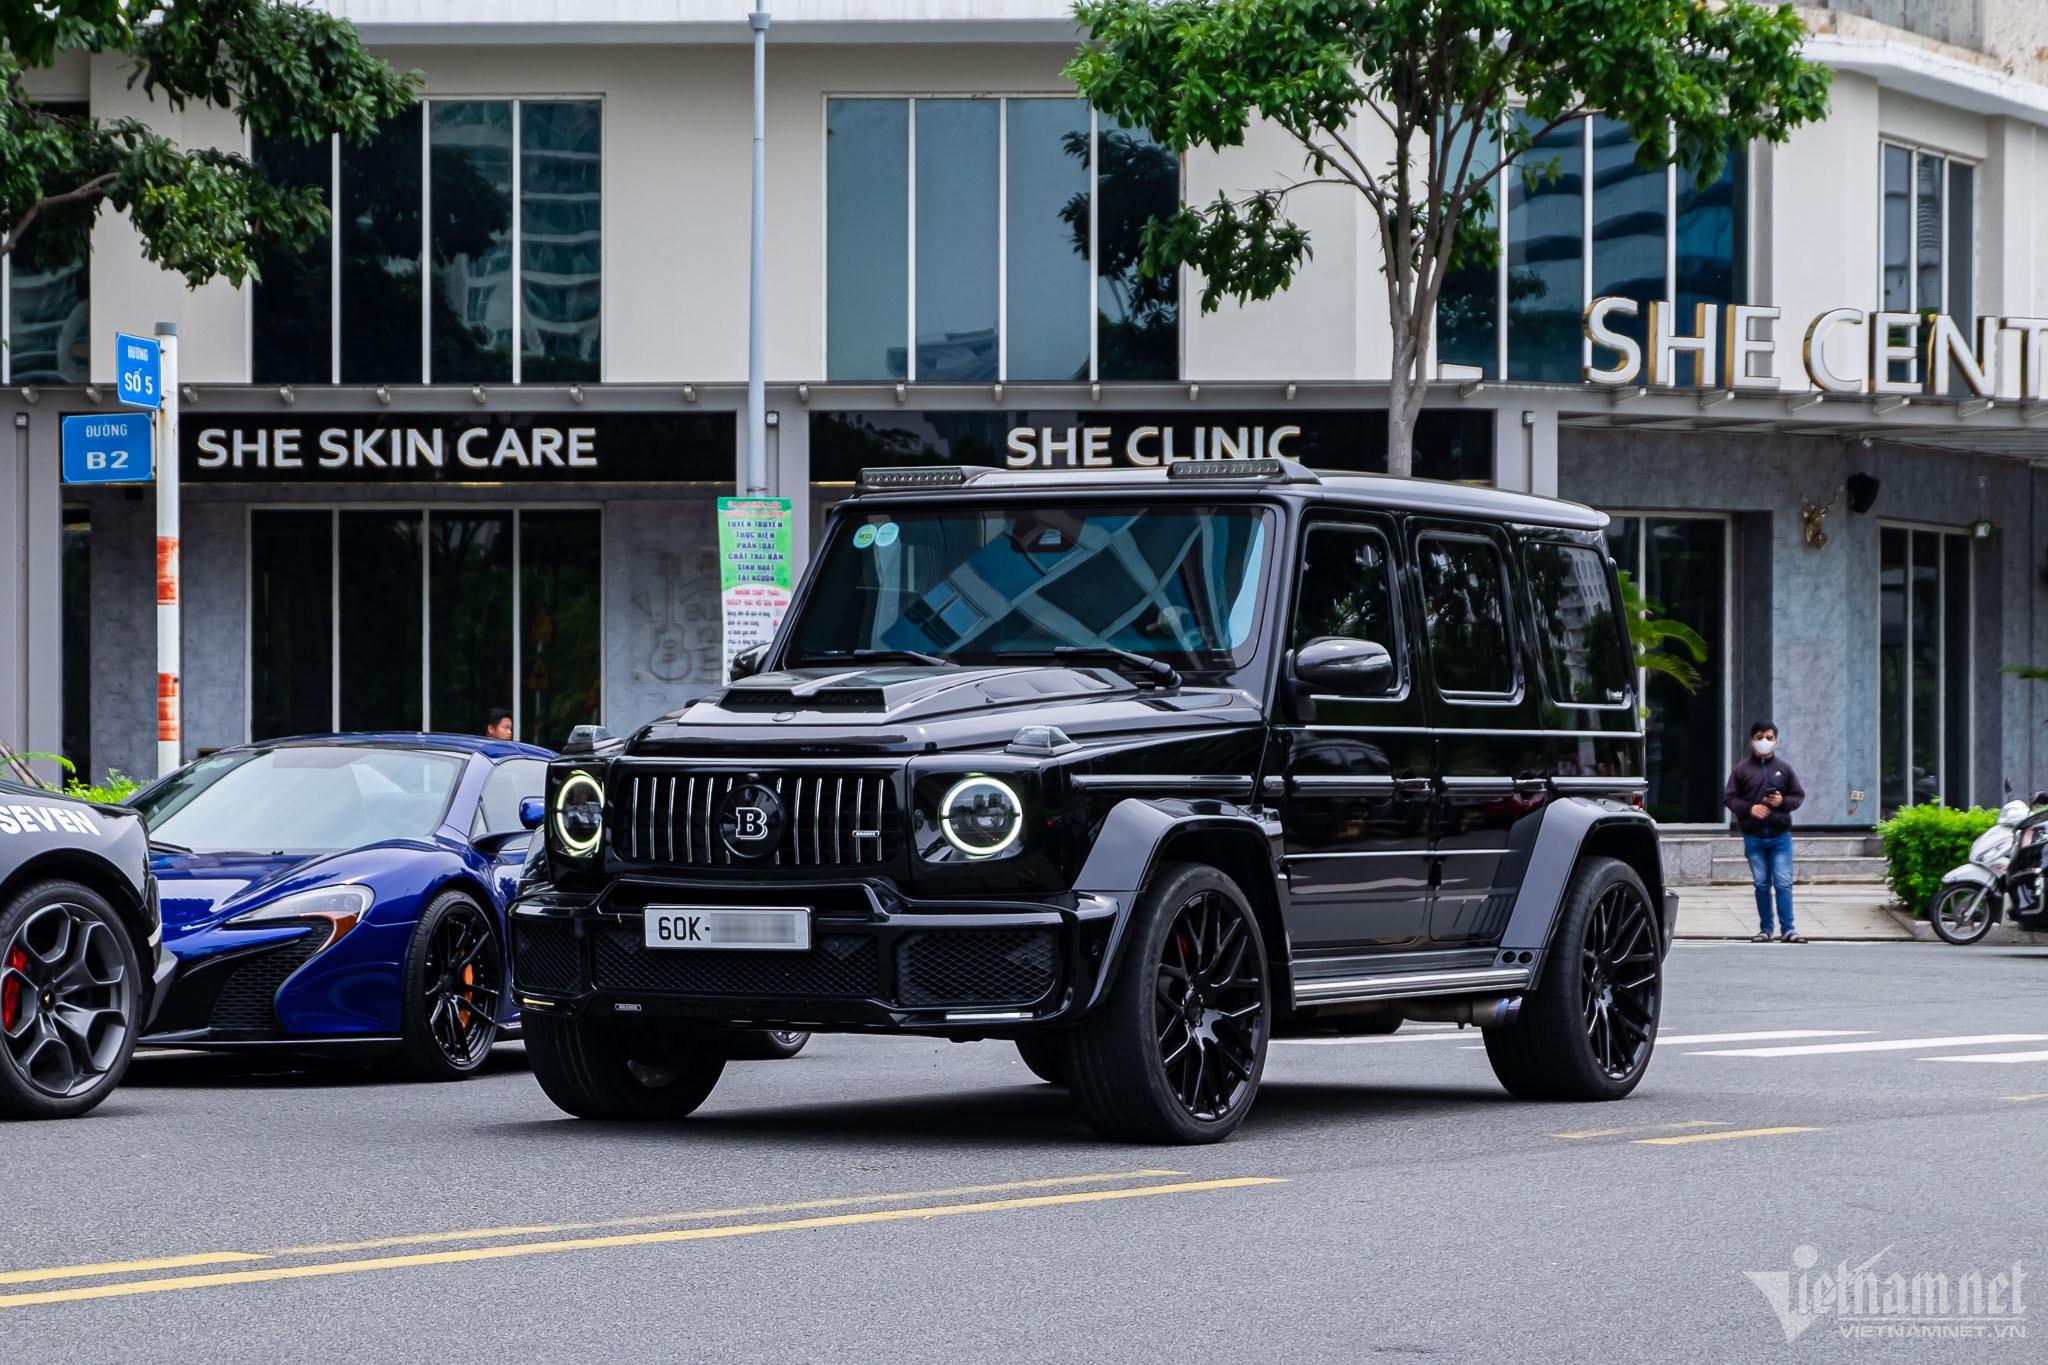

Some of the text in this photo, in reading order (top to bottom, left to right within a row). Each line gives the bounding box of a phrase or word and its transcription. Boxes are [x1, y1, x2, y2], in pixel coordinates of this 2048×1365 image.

[1583, 296, 1781, 388] SHE
[124, 367, 153, 395] SỐ 5
[86, 450, 129, 470] B2
[197, 427, 598, 468] SHE SKIN CARE
[1006, 426, 1301, 467] SHE CLINIC
[0, 805, 101, 836] SEVEN
[736, 807, 768, 840] B
